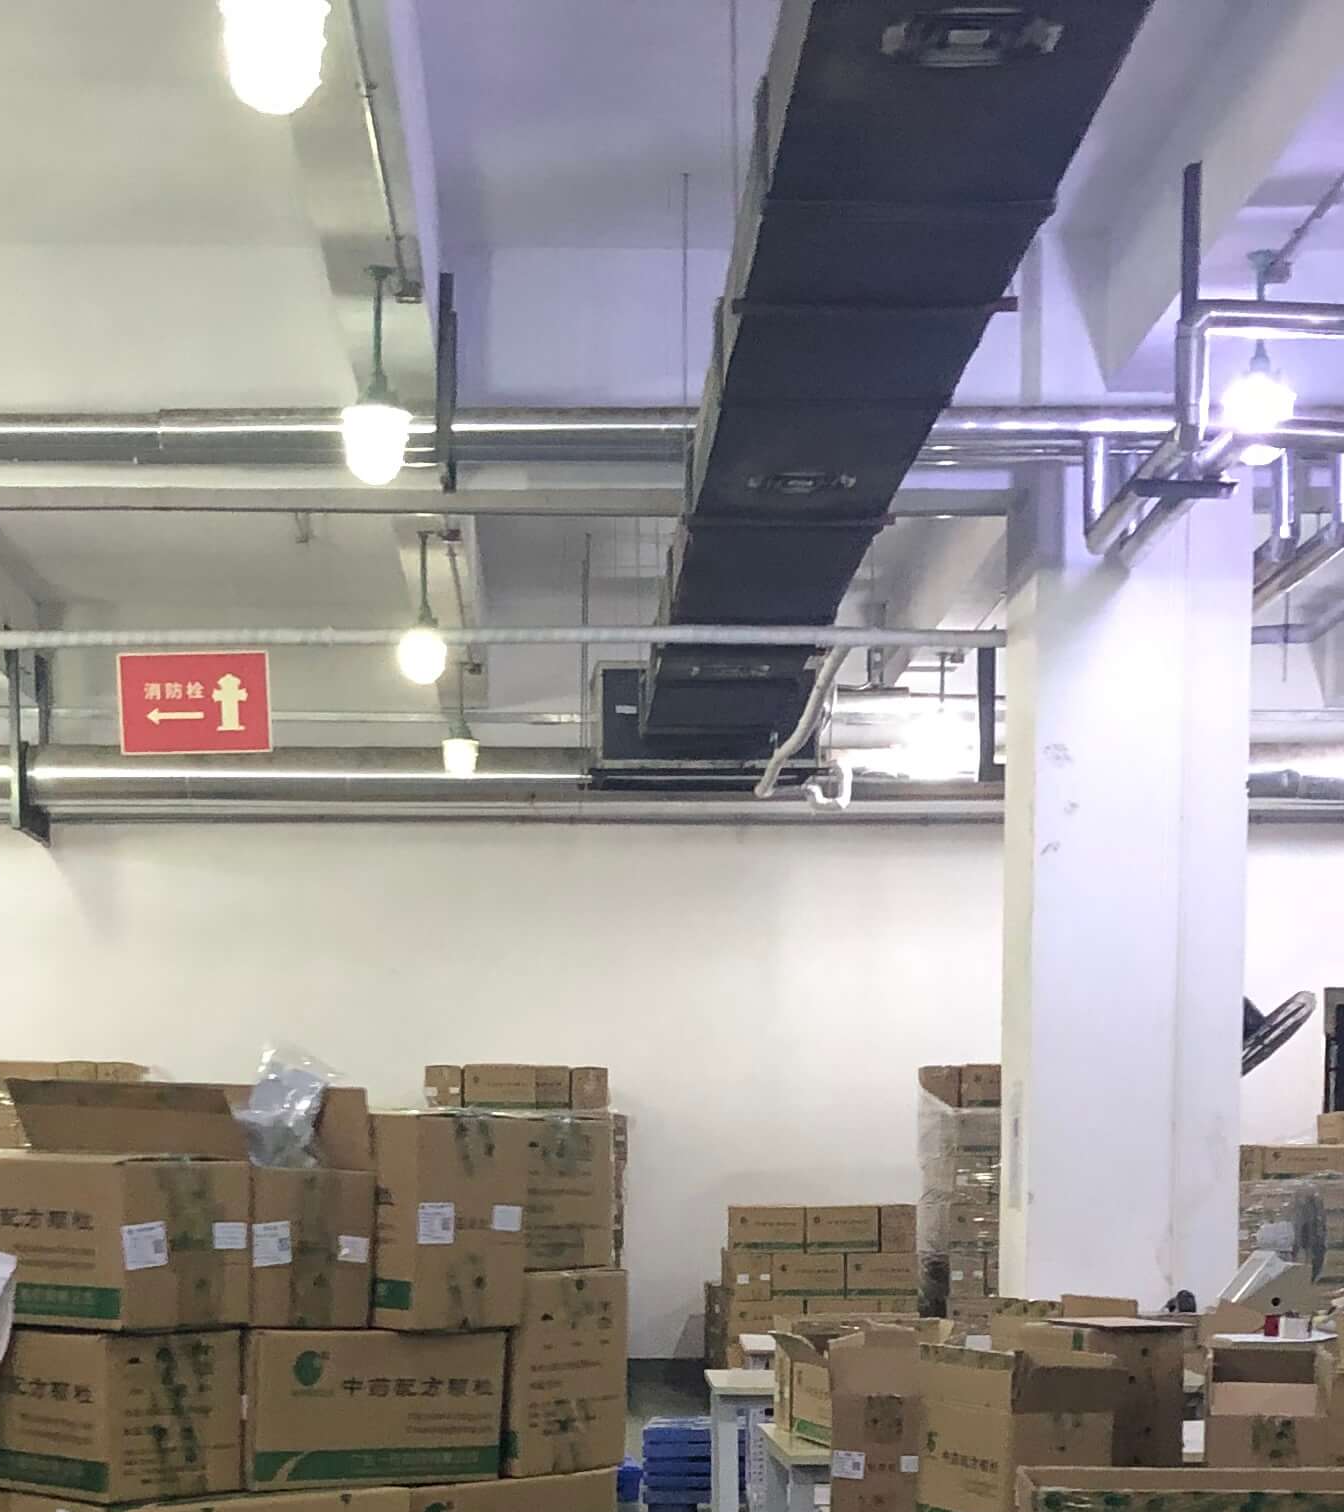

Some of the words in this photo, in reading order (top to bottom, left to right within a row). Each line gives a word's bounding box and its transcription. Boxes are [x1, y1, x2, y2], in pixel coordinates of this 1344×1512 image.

[144, 681, 205, 700] 消防栓
[343, 1375, 495, 1398] 中药配方颗粒
